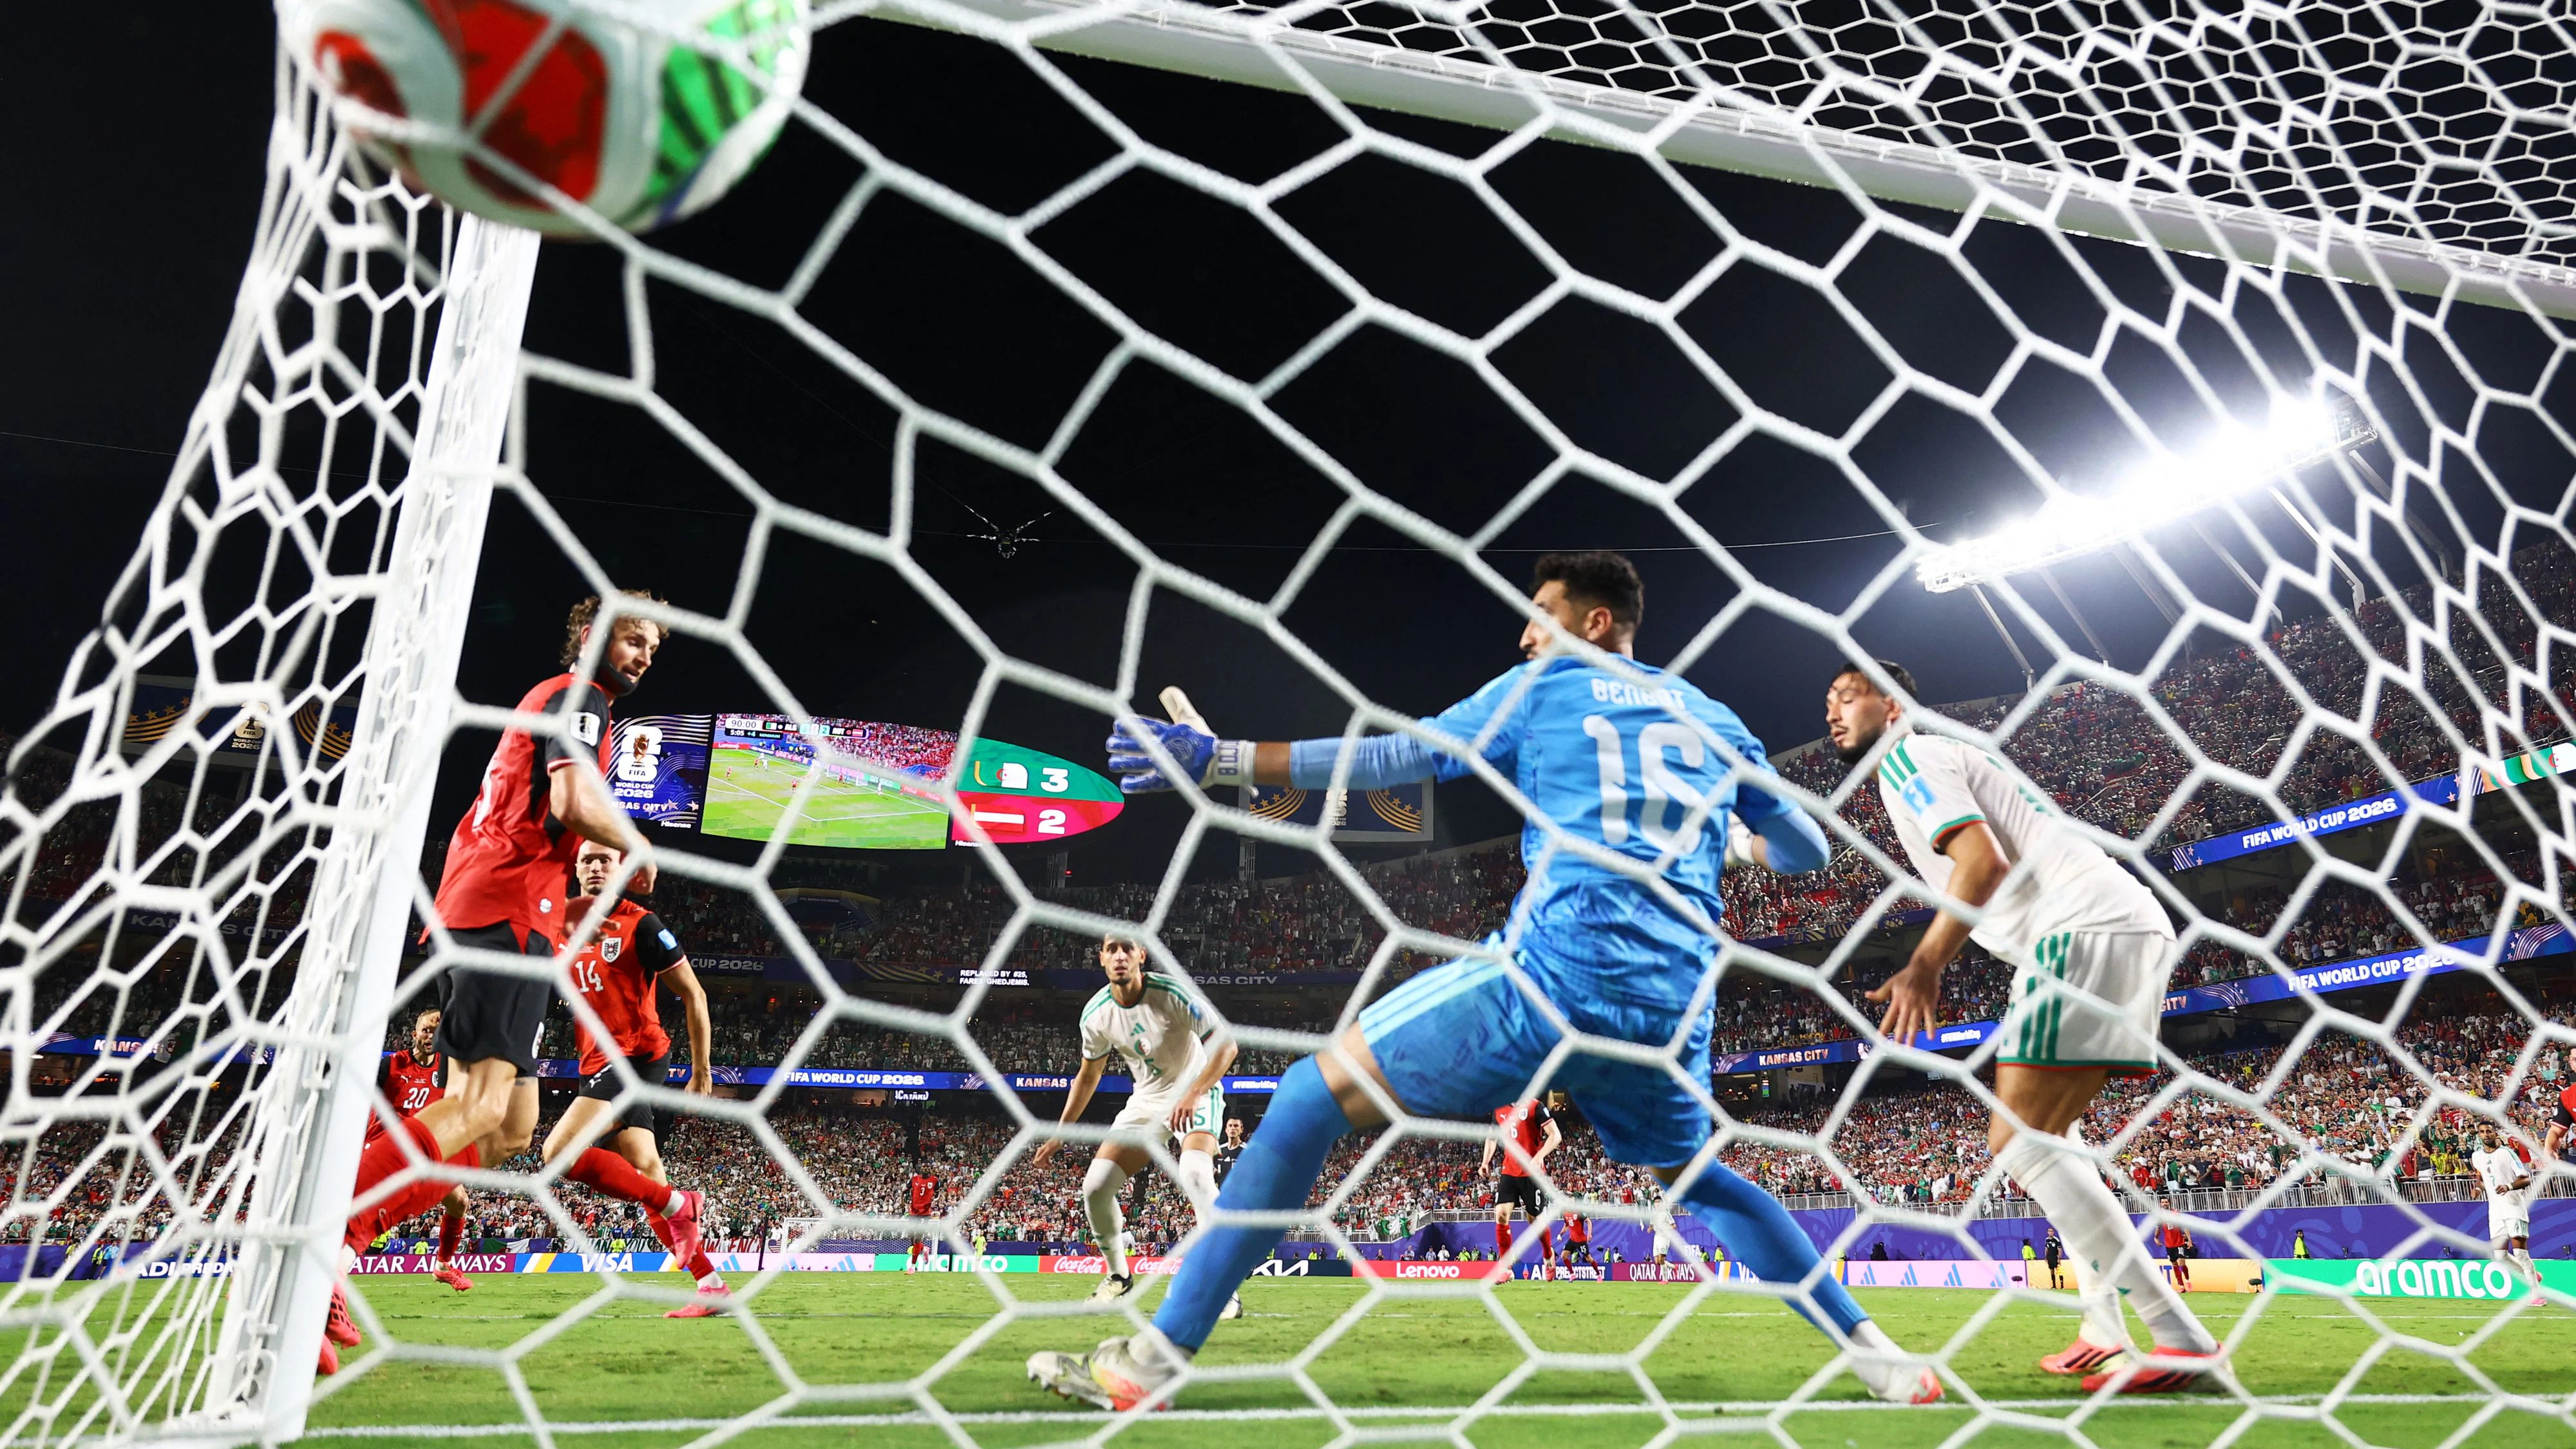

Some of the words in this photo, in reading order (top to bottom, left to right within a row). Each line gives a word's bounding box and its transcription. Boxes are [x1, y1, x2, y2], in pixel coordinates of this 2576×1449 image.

[732, 720, 756, 728] 90:00
[1040, 768, 1068, 793] 3
[1582, 714, 1705, 855] 16
[614, 788, 654, 799] 2026
[1037, 809, 1066, 835] 2
[2242, 830, 2272, 849] FIFA
[2271, 819, 2318, 841] WORLD
[2320, 810, 2346, 829] CUP
[2347, 797, 2397, 822] 2026
[690, 958, 717, 969] CUP
[718, 960, 764, 971] 2026
[574, 960, 603, 992] 14
[1235, 976, 1278, 985] CITY
[2288, 973, 2318, 991] FIFA
[2318, 965, 2370, 986] WORLD
[2371, 960, 2401, 978] CUP
[1759, 1051, 1803, 1066] KANSAS
[1804, 1048, 1829, 1061] CITY
[783, 1072, 810, 1082] FIFA
[811, 1073, 855, 1084] WORLD
[857, 1074, 882, 1084] CUP
[882, 1074, 924, 1086] 2026
[1016, 1077, 1067, 1088] KANSAS
[402, 1087, 430, 1109] 20
[1510, 1121, 1518, 1139] 6
[920, 1187, 925, 1196] 3
[1535, 1189, 1541, 1206] 6
[348, 1256, 404, 1273] ATAR
[577, 1253, 633, 1272] VISA
[1396, 1262, 1460, 1278] Lenovo
[1629, 1264, 1656, 1282] QATAR
[2356, 1260, 2513, 1299] aramco
